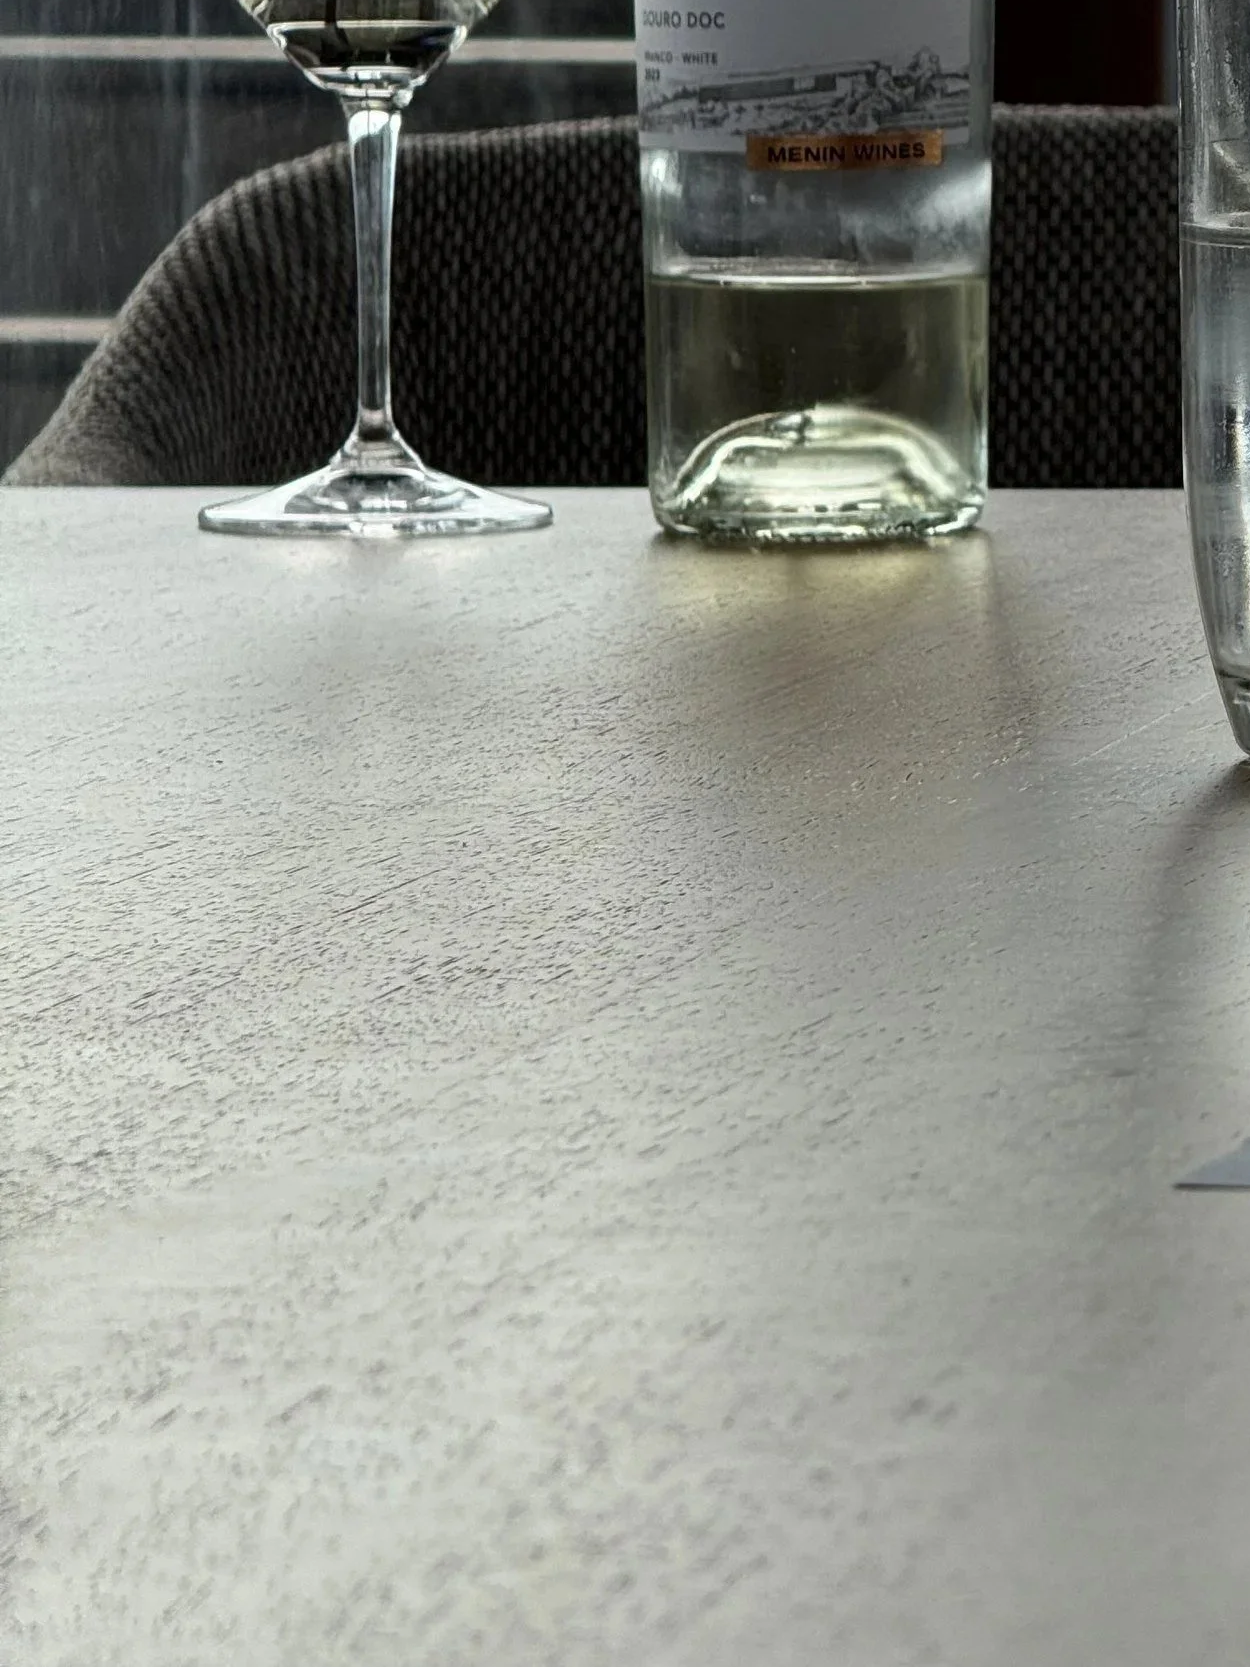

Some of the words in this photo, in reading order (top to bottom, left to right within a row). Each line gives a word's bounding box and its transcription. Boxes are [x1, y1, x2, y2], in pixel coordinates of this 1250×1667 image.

[687, 11, 725, 30] DOC
[681, 52, 717, 65] WHITE
[767, 145, 846, 163] MENIN
[853, 141, 926, 161] WINES
